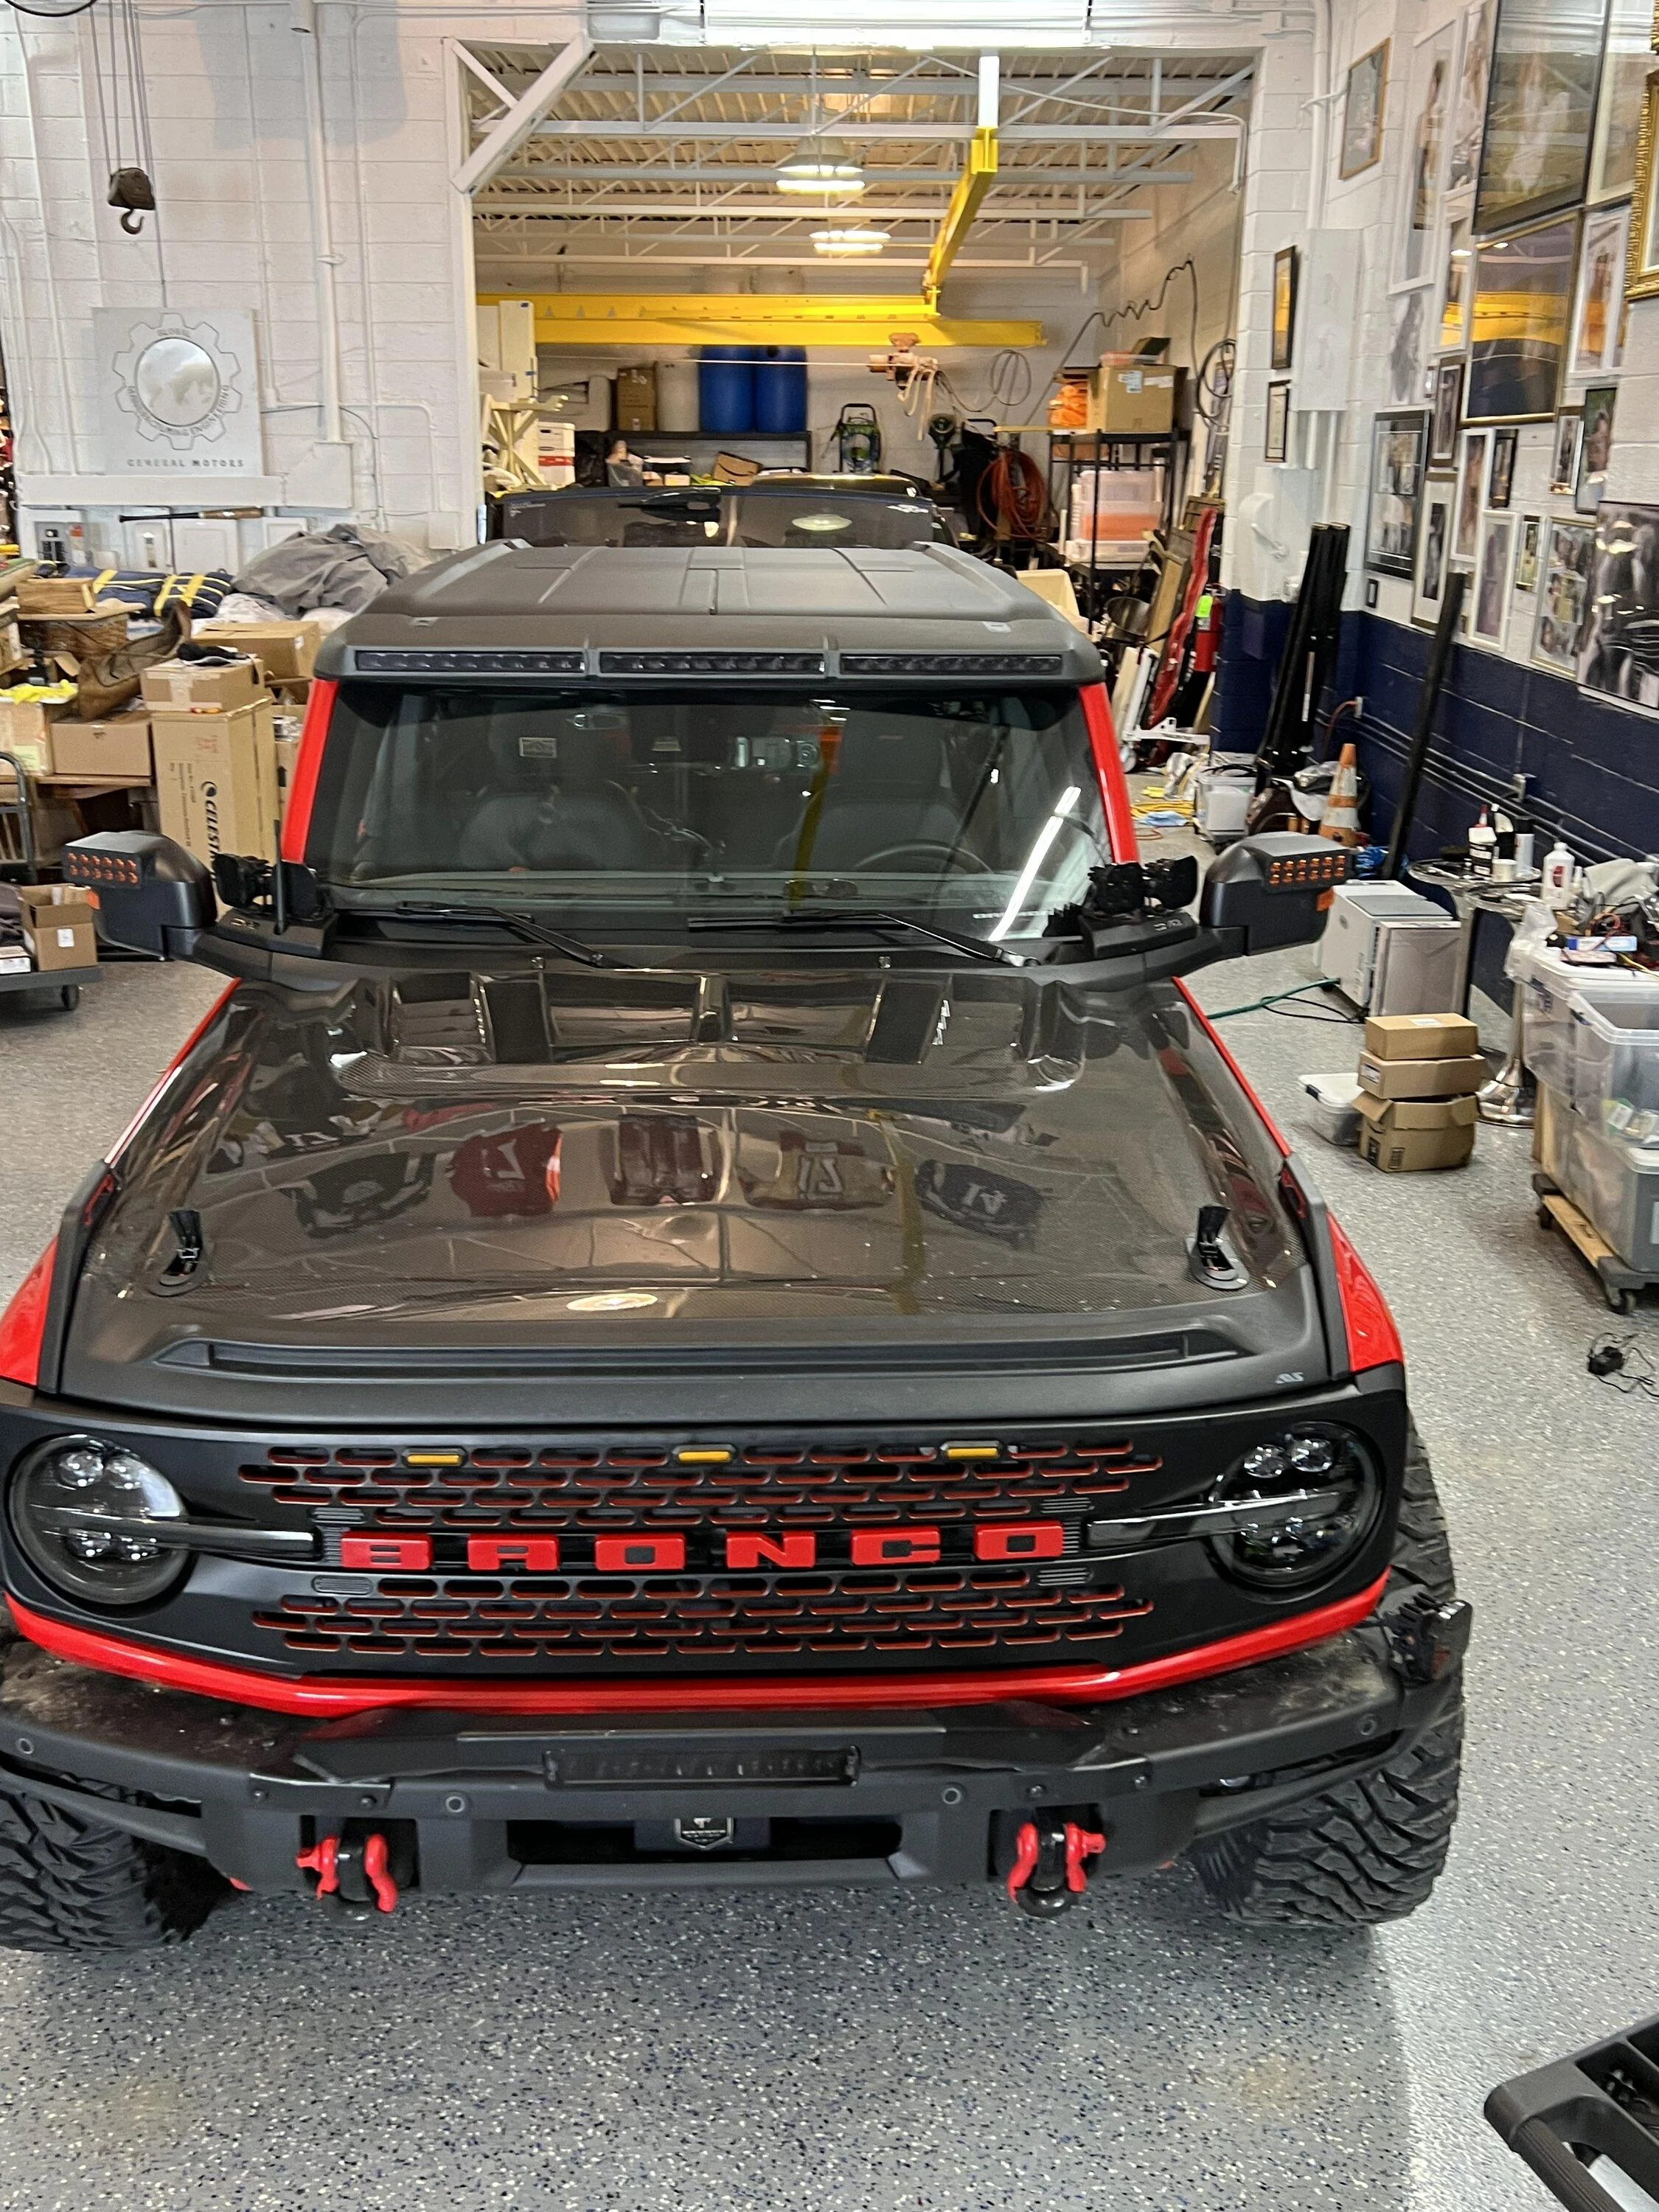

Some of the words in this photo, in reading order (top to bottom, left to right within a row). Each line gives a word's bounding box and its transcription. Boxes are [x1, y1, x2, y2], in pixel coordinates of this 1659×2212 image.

[127, 459, 186, 467] GENERAL
[192, 459, 244, 467] MOTORS
[340, 1522, 1065, 1571] BRONCO
